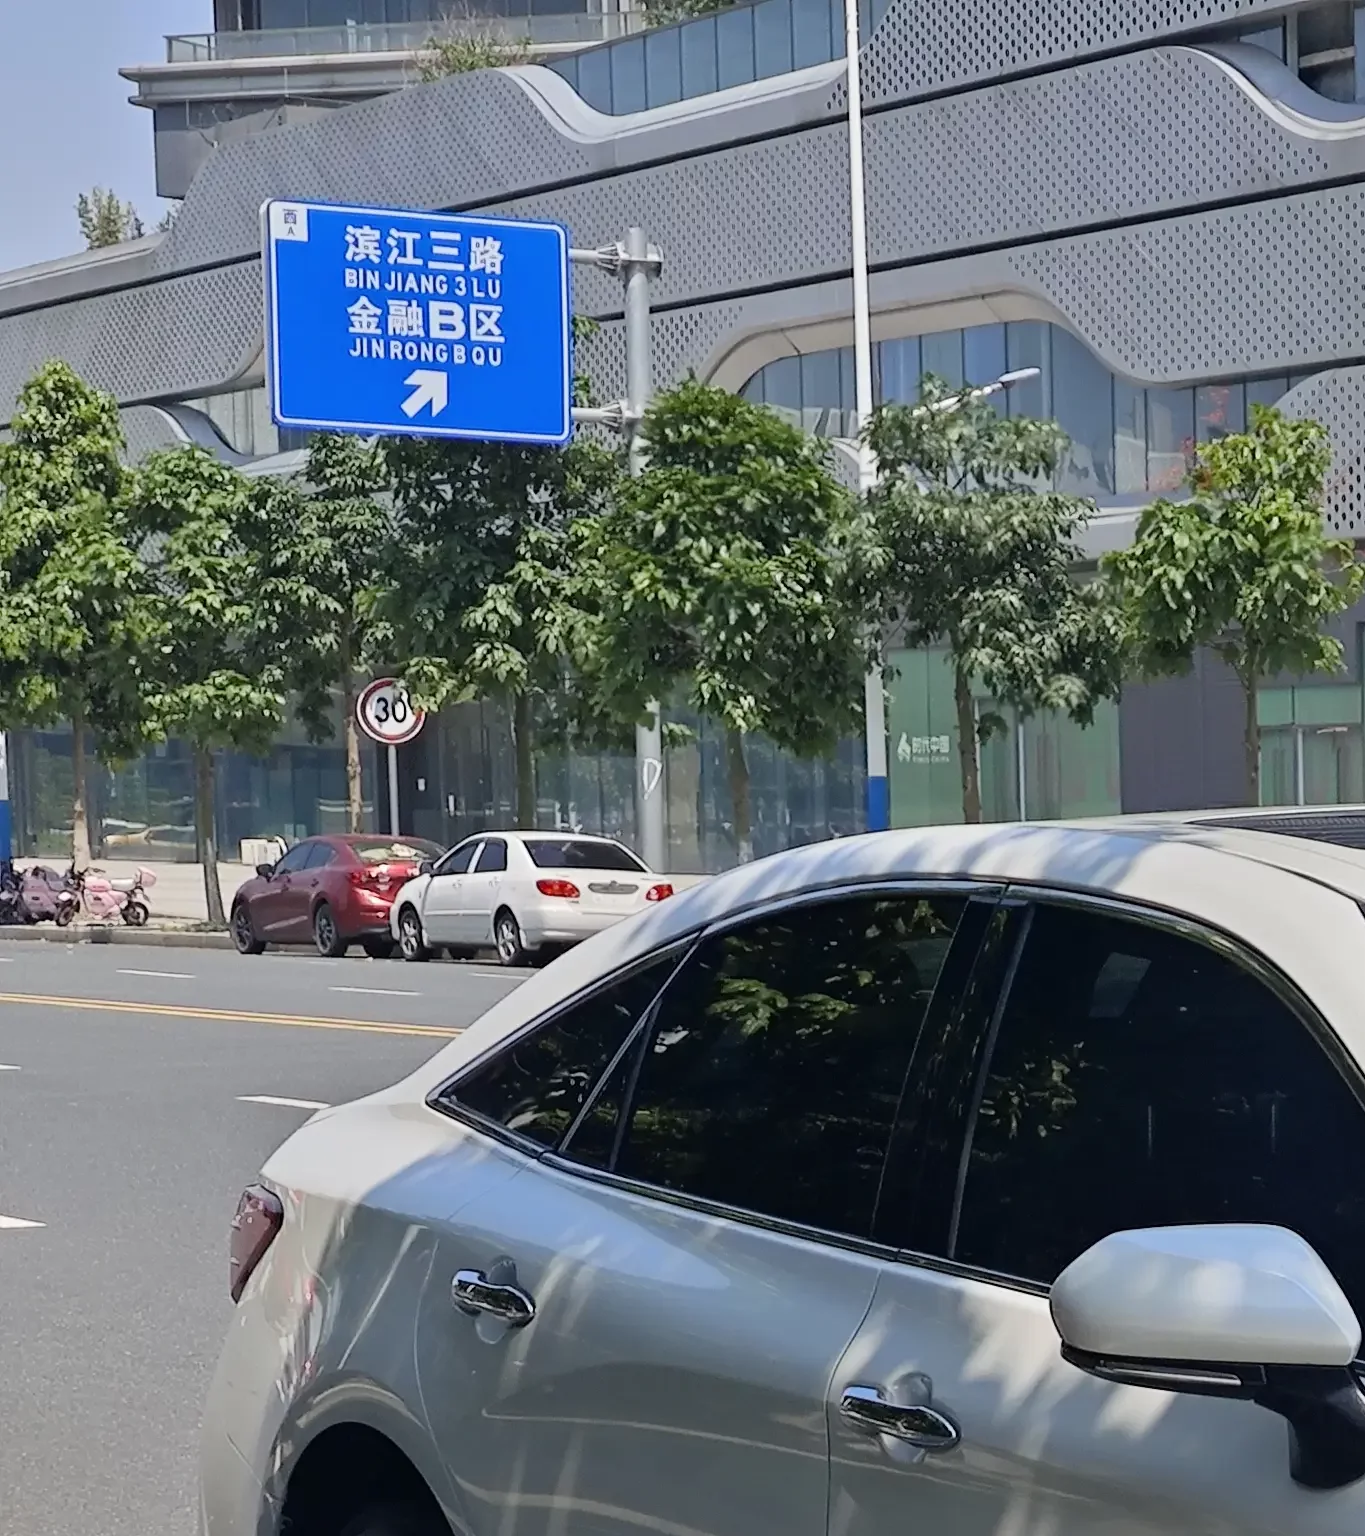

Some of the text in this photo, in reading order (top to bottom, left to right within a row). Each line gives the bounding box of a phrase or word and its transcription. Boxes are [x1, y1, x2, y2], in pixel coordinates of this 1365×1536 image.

[344, 225, 505, 275] 滨江三路
[454, 275, 467, 297] 3
[471, 276, 501, 299] LU
[346, 295, 506, 344] 金融B区
[375, 696, 407, 724] 30
